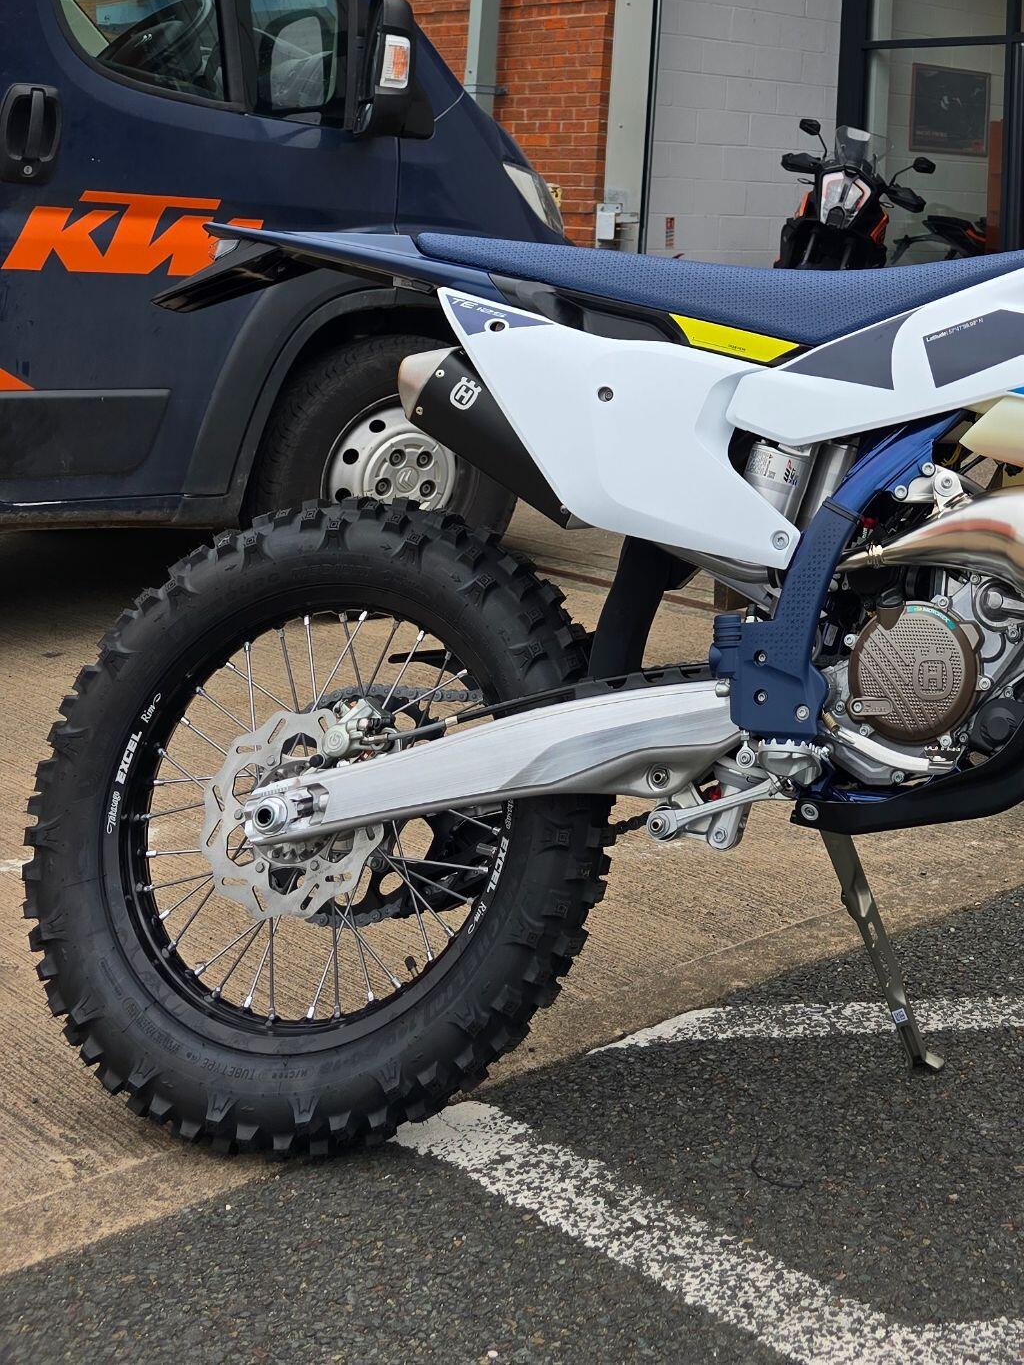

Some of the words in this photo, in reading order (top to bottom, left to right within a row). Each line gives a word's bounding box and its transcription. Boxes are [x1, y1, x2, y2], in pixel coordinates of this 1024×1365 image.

[451, 297, 479, 309] TE
[115, 731, 143, 785] EXCEL
[140, 692, 162, 724] Rim
[487, 836, 510, 894] EXCEL
[468, 900, 487, 935] Rim
